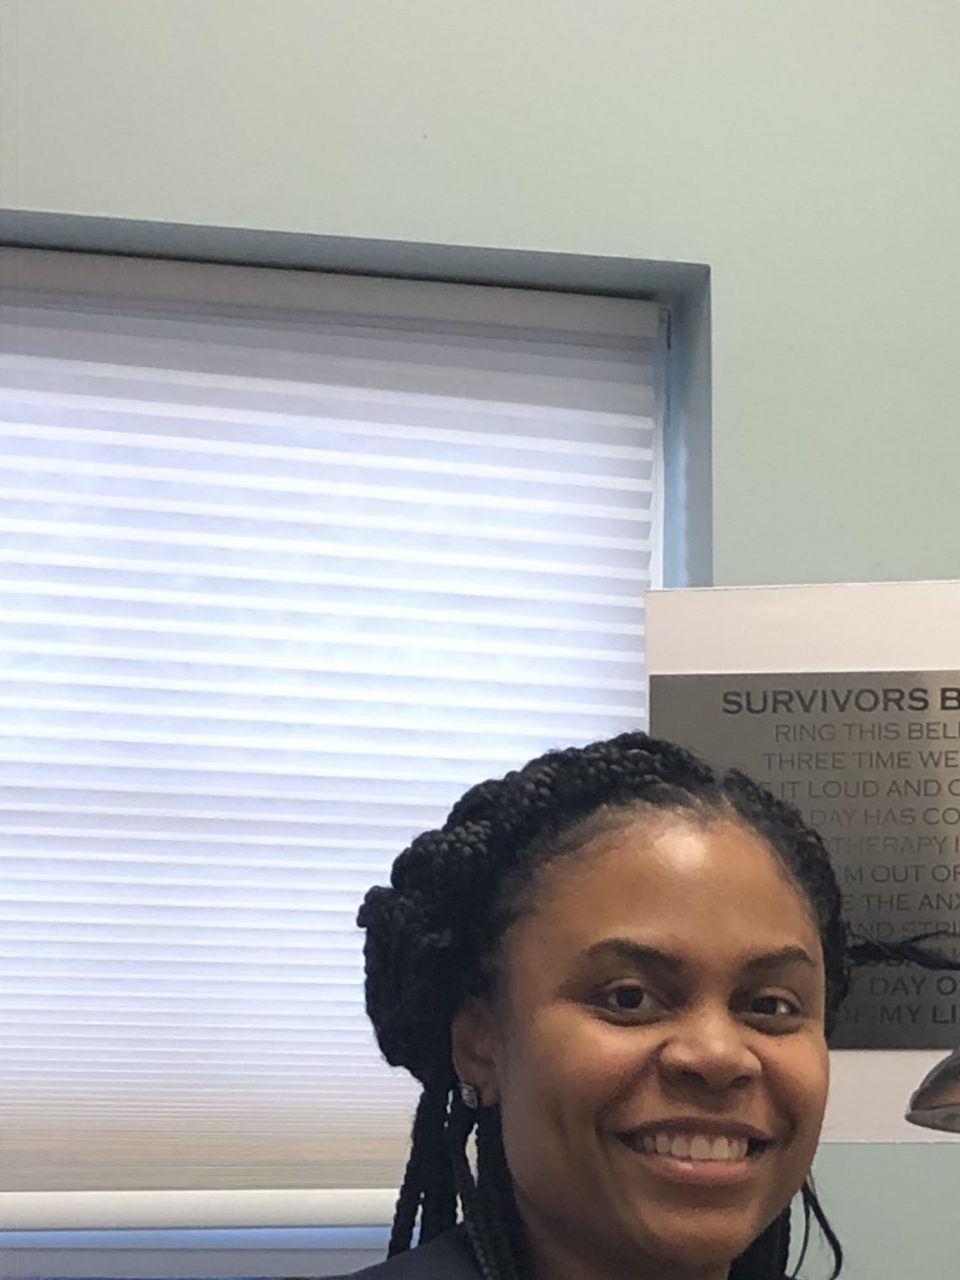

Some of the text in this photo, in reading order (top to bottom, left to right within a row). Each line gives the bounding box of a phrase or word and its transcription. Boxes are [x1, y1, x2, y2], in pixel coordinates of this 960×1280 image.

[722, 688, 929, 714] SURVIVORS
[774, 723, 836, 743] RING
[843, 722, 900, 742] THIS
[763, 753, 846, 770] THREE
[850, 752, 911, 769] TIME
[780, 780, 802, 798] IT
[808, 780, 880, 798] LOUD
[886, 779, 942, 797] AND
[809, 808, 858, 827] DAY
[863, 808, 915, 826] HAS
[870, 864, 926, 883] OUT
[861, 894, 911, 911] THE
[869, 976, 926, 996] DAY
[879, 1005, 923, 1024] MY
